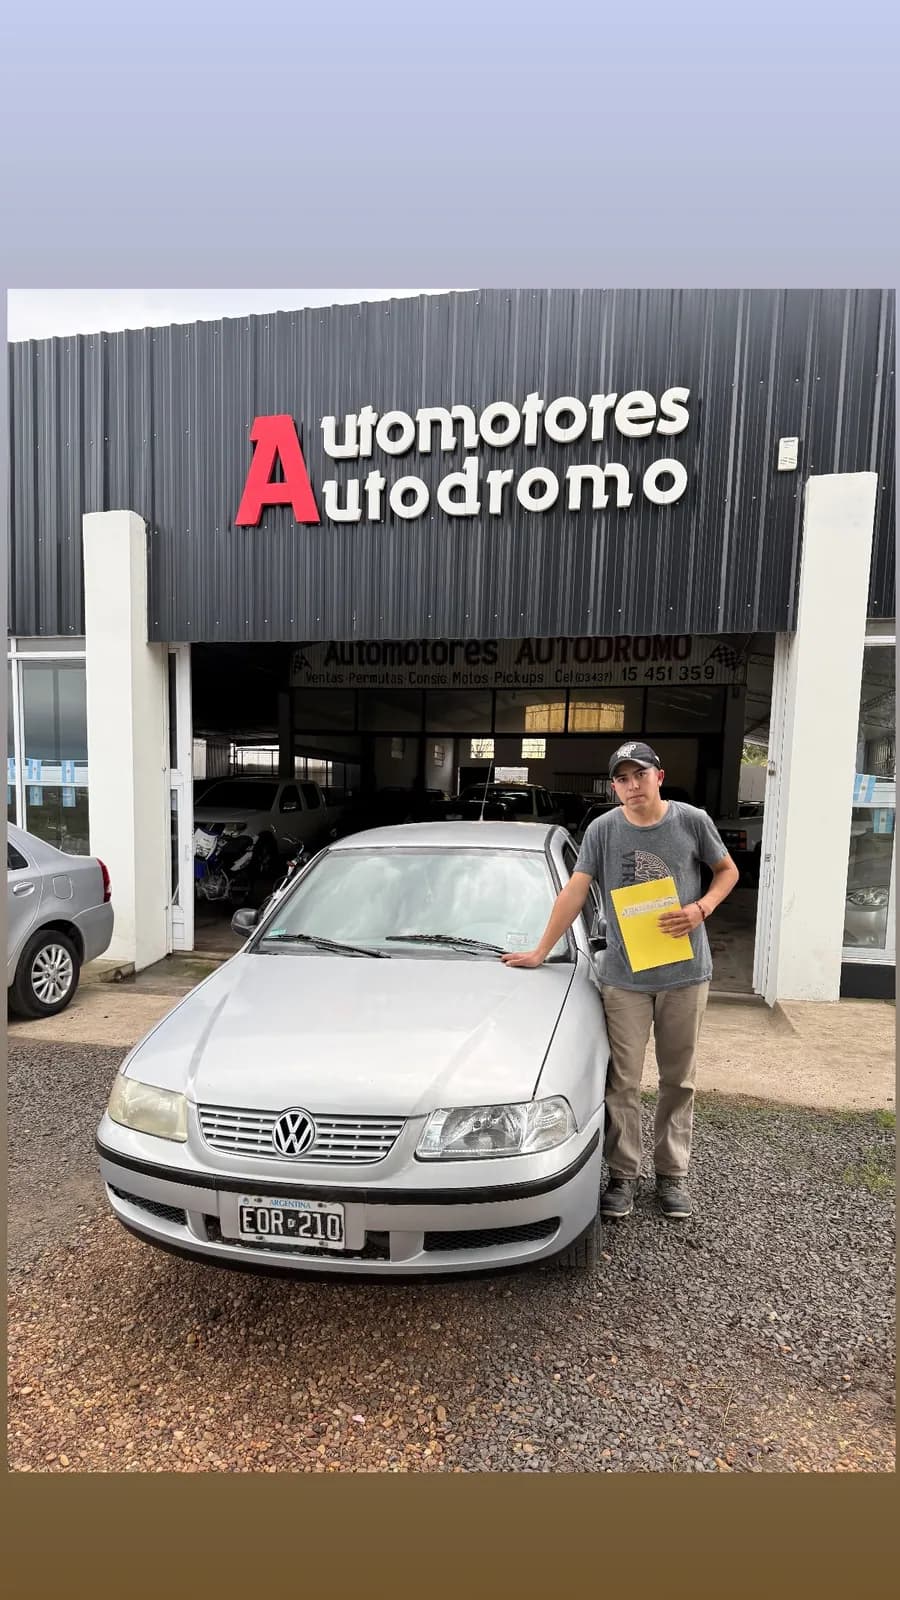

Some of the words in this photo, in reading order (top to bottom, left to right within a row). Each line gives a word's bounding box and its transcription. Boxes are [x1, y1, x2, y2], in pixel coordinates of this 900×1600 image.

[324, 640, 498, 666] Automotores
[515, 636, 693, 665] AUTODROMO
[494, 671, 544, 687] Pickups
[622, 666, 638, 681] 15
[644, 665, 672, 681] 451
[679, 665, 715, 681] 359
[269, 1199, 311, 1209] ARGENTINA
[242, 1207, 284, 1235] EOR
[298, 1211, 341, 1240] 210
